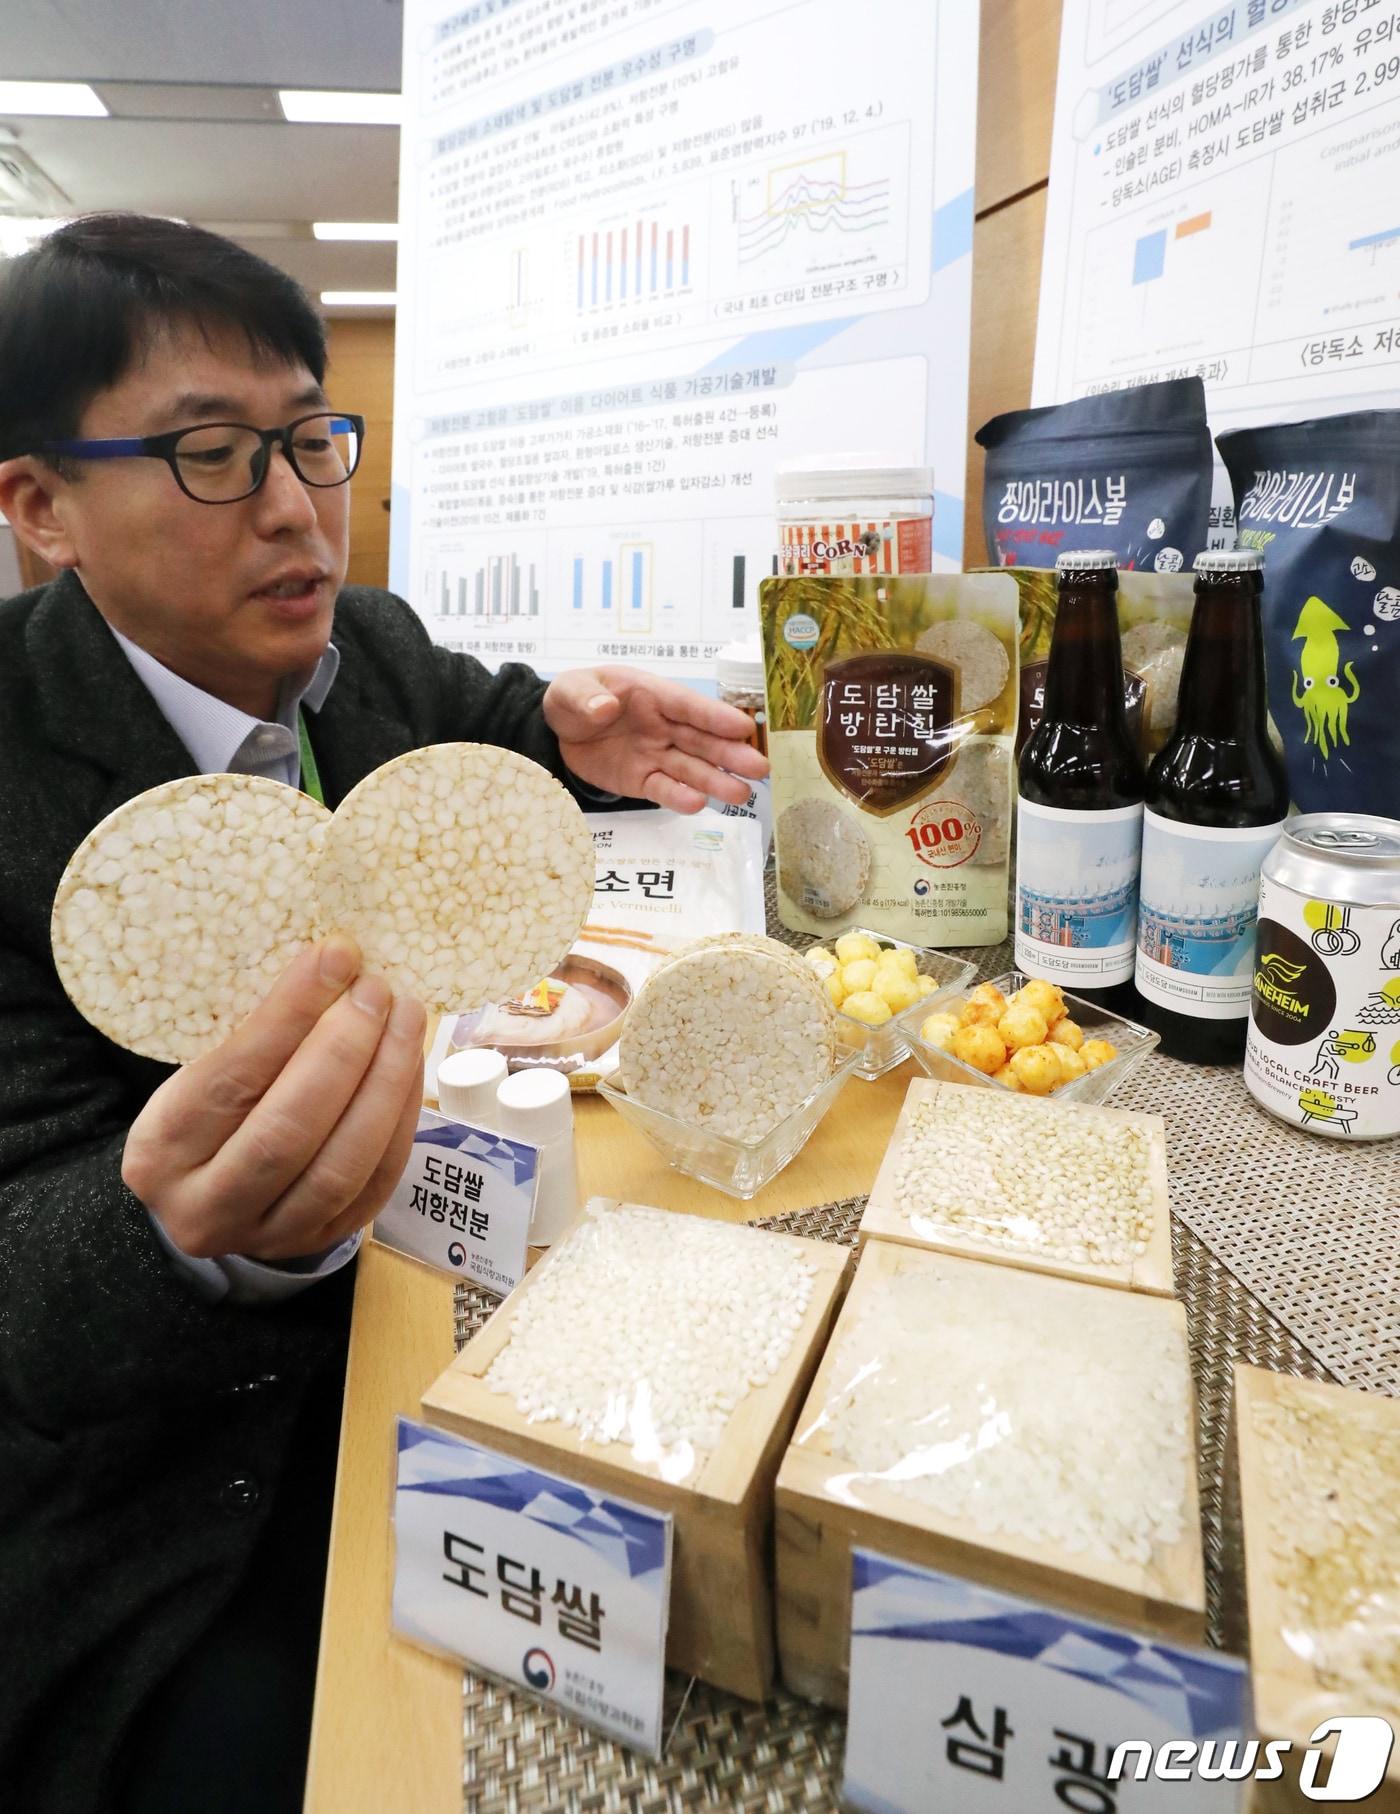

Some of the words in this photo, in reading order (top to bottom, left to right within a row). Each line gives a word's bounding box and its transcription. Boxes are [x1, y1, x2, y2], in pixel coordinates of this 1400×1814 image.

[668, 36, 696, 62] 구명
[1176, 9, 1235, 71] 선식의
[1105, 116, 1141, 152] 도담쌀
[1145, 92, 1185, 130] 선식의
[1191, 45, 1268, 107] 혈당평가를
[1276, 19, 1312, 60] 통한
[1115, 144, 1149, 176] 인슐린
[1281, 43, 1344, 93] 38.17%
[1188, 134, 1230, 170] 측정시
[1236, 109, 1285, 150] 도담쌀
[1292, 79, 1346, 125] 섭취군
[591, 388, 642, 409] 다이어트
[650, 382, 677, 400] 식품
[685, 367, 776, 398] 가공기술개발
[756, 424, 778, 440] 선식
[731, 472, 752, 487] 개선
[813, 539, 867, 560] CORN
[788, 625, 815, 634] HACCP
[905, 818, 981, 851] 100%
[1260, 1049, 1290, 1076] LOCAL
[1294, 1069, 1339, 1091] CRAFT
[1344, 1082, 1379, 1095] BEER
[1322, 1091, 1357, 1104] TASTY
[423, 1156, 484, 1203] 도담쌀
[409, 1184, 489, 1241] 저항전분
[443, 1531, 606, 1653] 도담쌀
